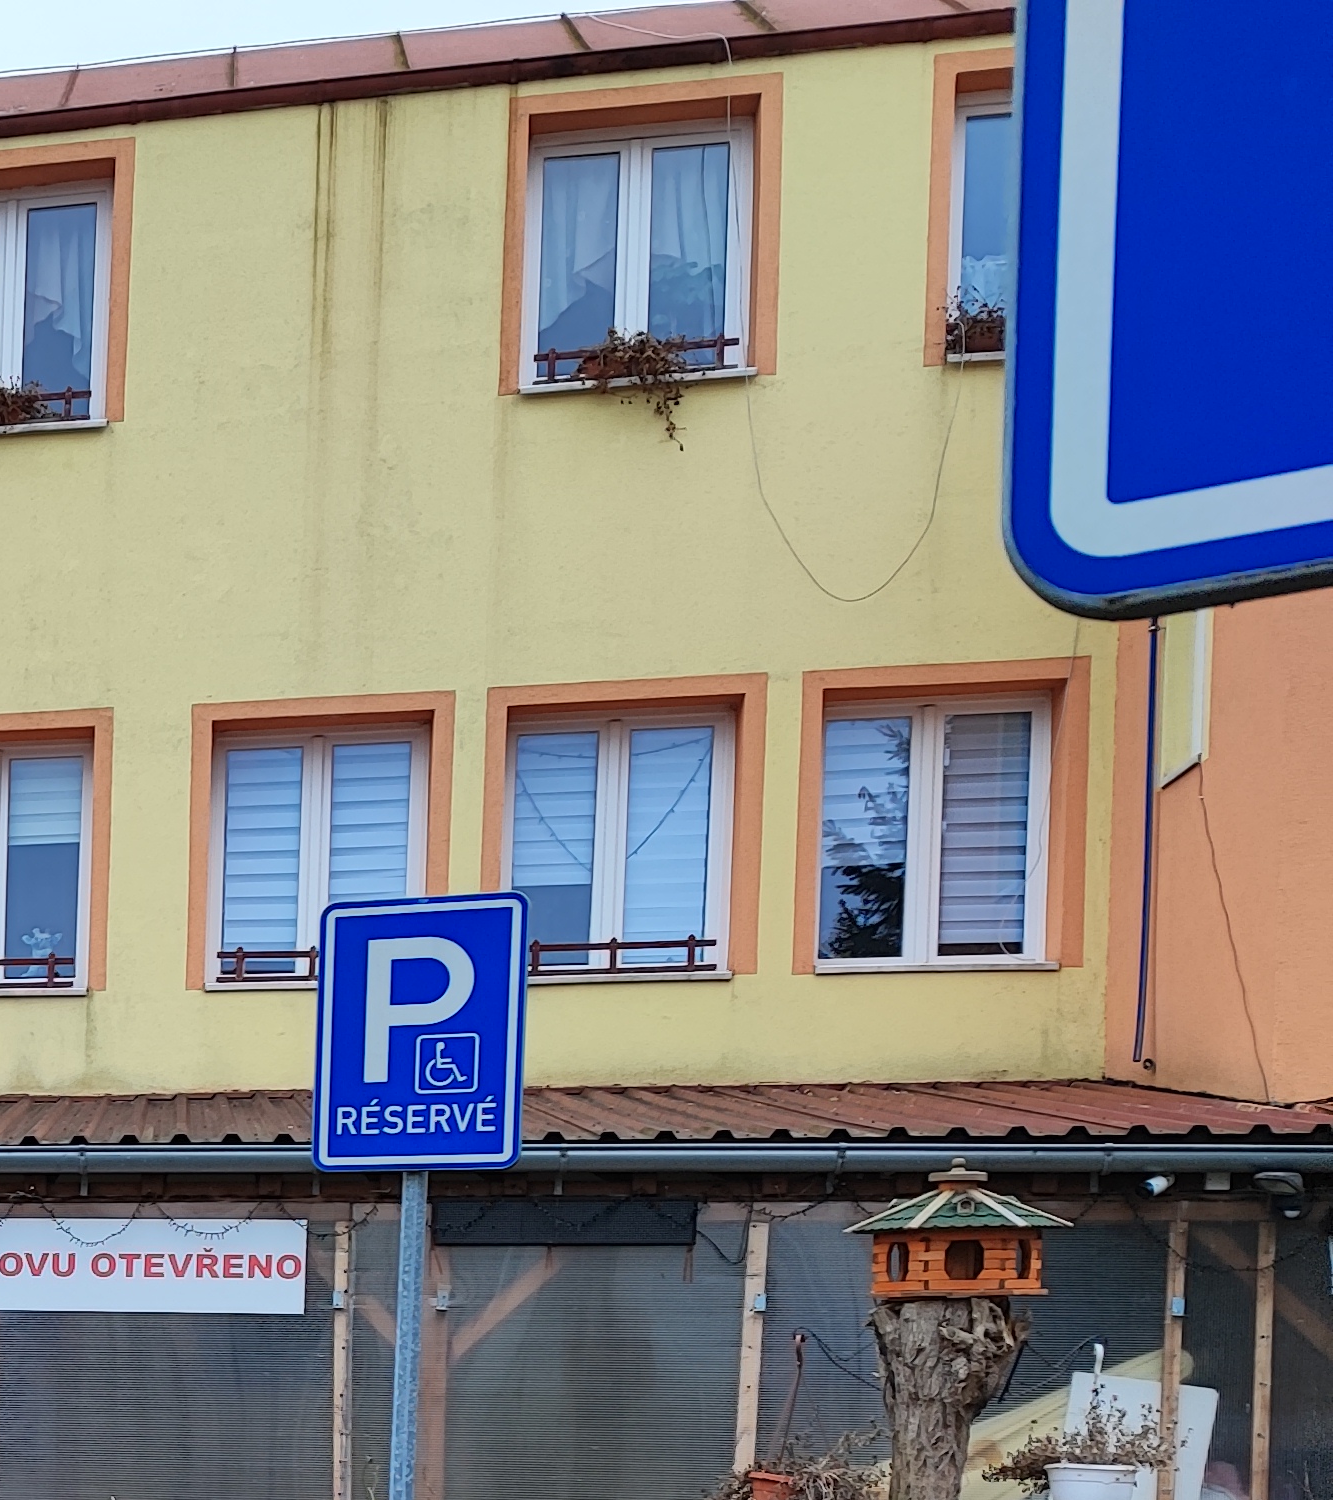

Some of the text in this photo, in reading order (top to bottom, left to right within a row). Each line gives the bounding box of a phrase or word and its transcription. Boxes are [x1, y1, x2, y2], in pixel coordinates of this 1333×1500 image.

[363, 936, 475, 1083] P
[335, 1096, 498, 1135] RÉSERVÉ
[91, 1247, 302, 1279] OTEVŘENO
